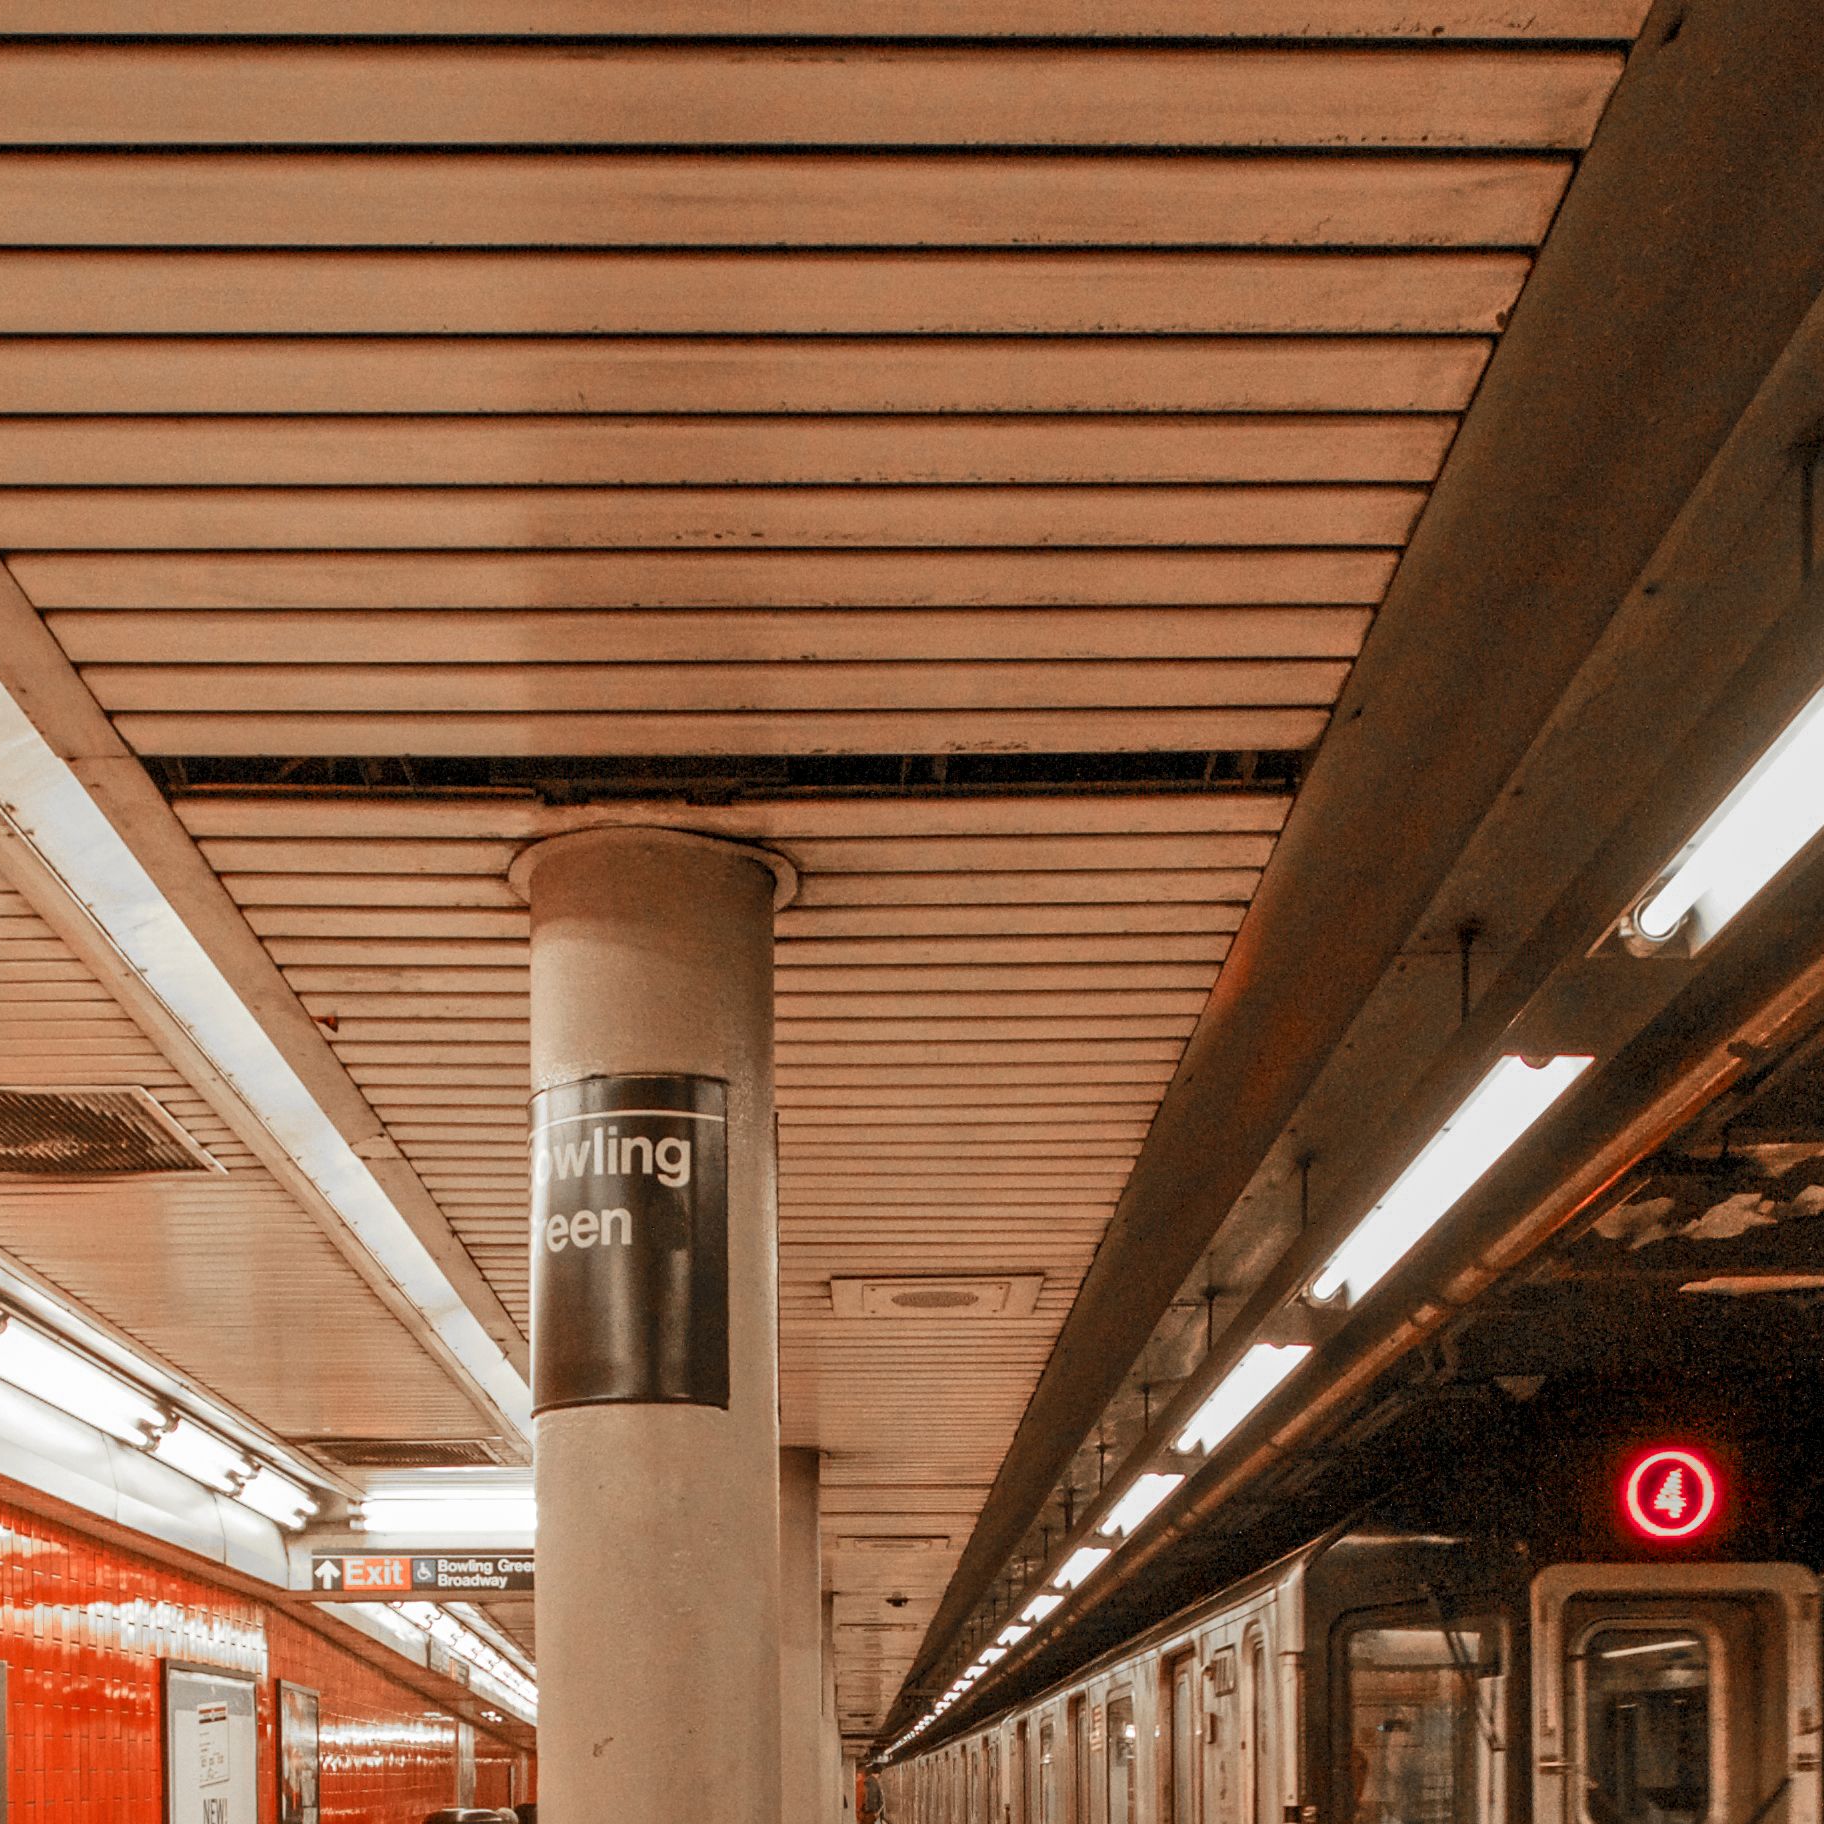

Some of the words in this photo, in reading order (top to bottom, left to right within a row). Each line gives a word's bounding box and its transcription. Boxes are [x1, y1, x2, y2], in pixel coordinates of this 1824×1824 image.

[534, 1125, 691, 1188] owling
[1653, 1467, 1688, 1519] 4
[344, 1559, 404, 1586] Exit
[437, 1559, 493, 1574] Bowling
[437, 1574, 508, 1589] Broadway
